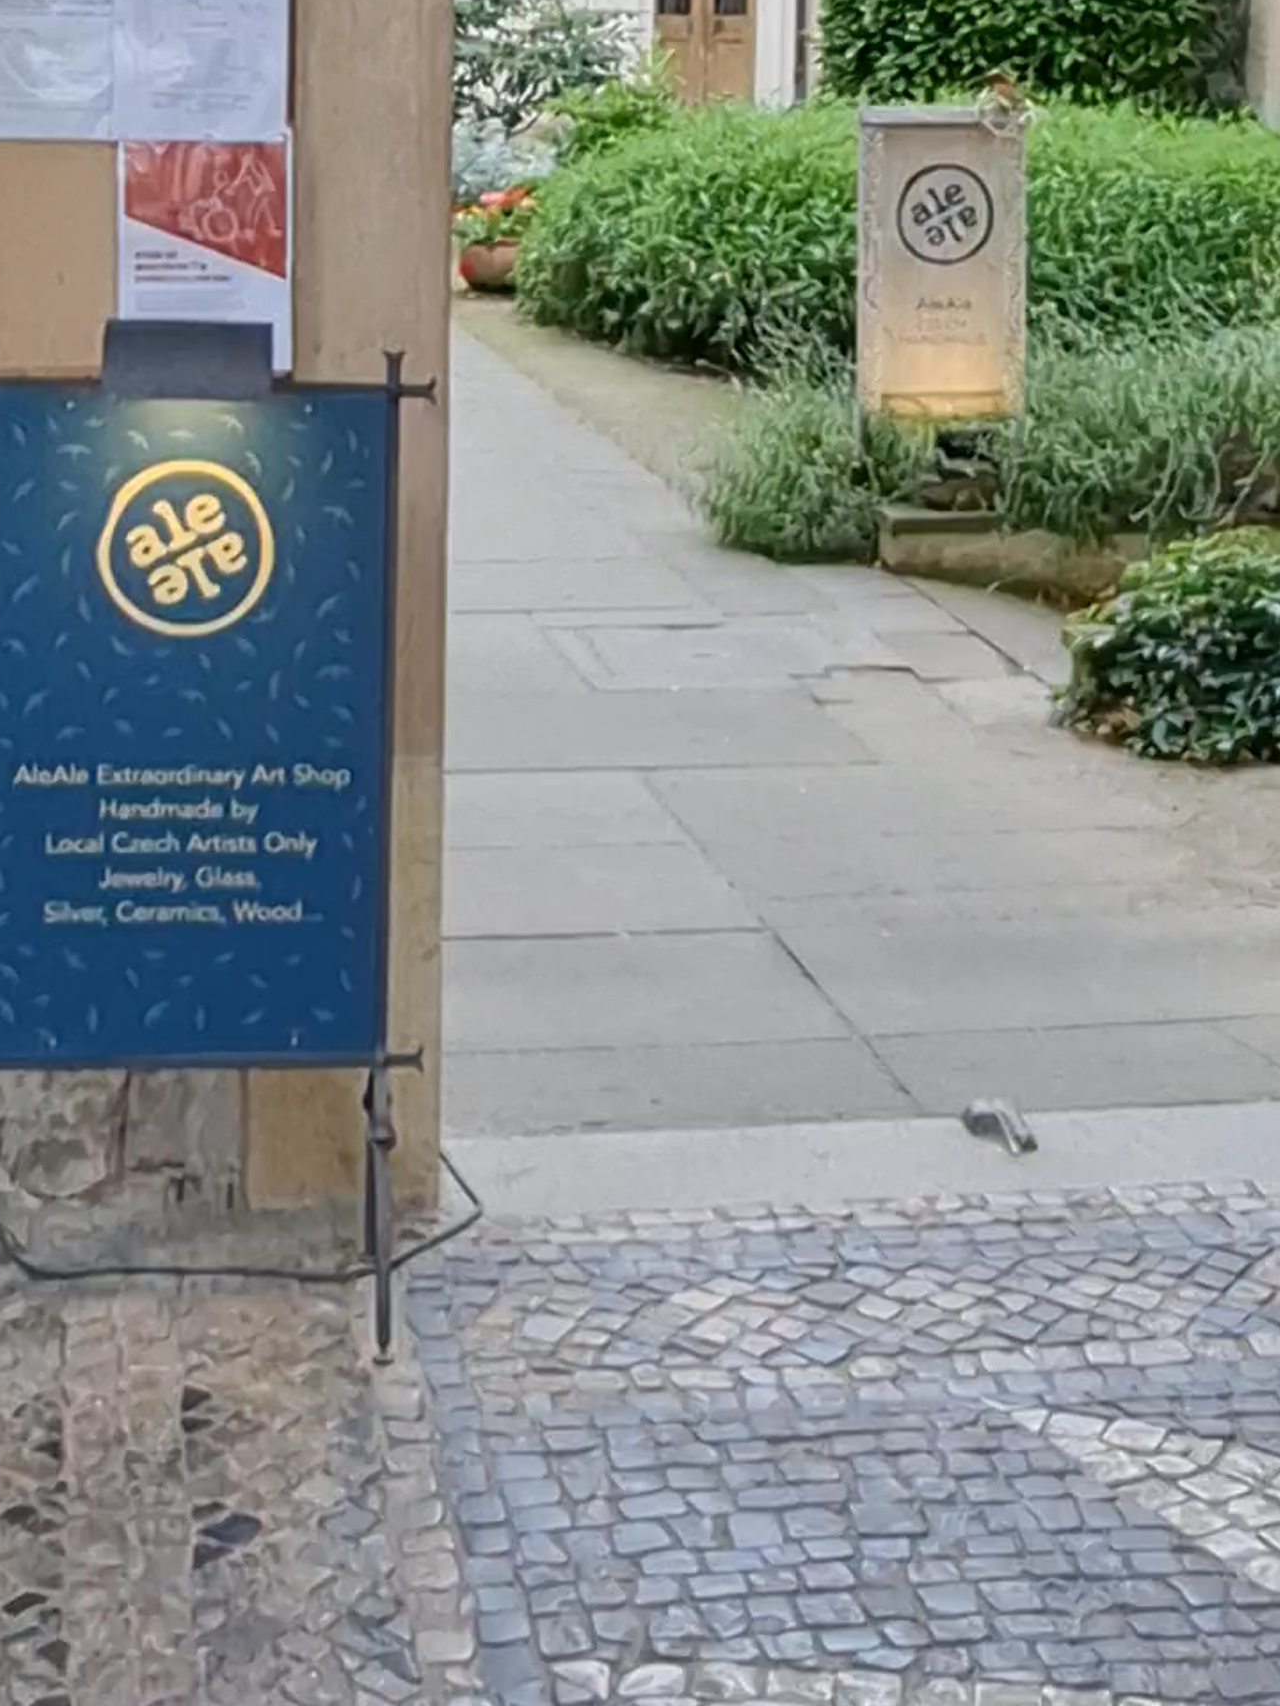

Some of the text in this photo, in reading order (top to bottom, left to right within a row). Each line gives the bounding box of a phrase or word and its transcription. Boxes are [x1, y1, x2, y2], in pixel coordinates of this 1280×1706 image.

[912, 183, 965, 226] ale
[126, 494, 226, 568] ale
[147, 532, 247, 604] ale
[13, 763, 351, 792] AleAle Extraordinary Art Shop
[99, 796, 259, 824] Handmade by
[45, 830, 318, 860] Local Czech Artists Only
[99, 865, 262, 893] Jewelry, Glass,
[43, 900, 107, 927] Silver,
